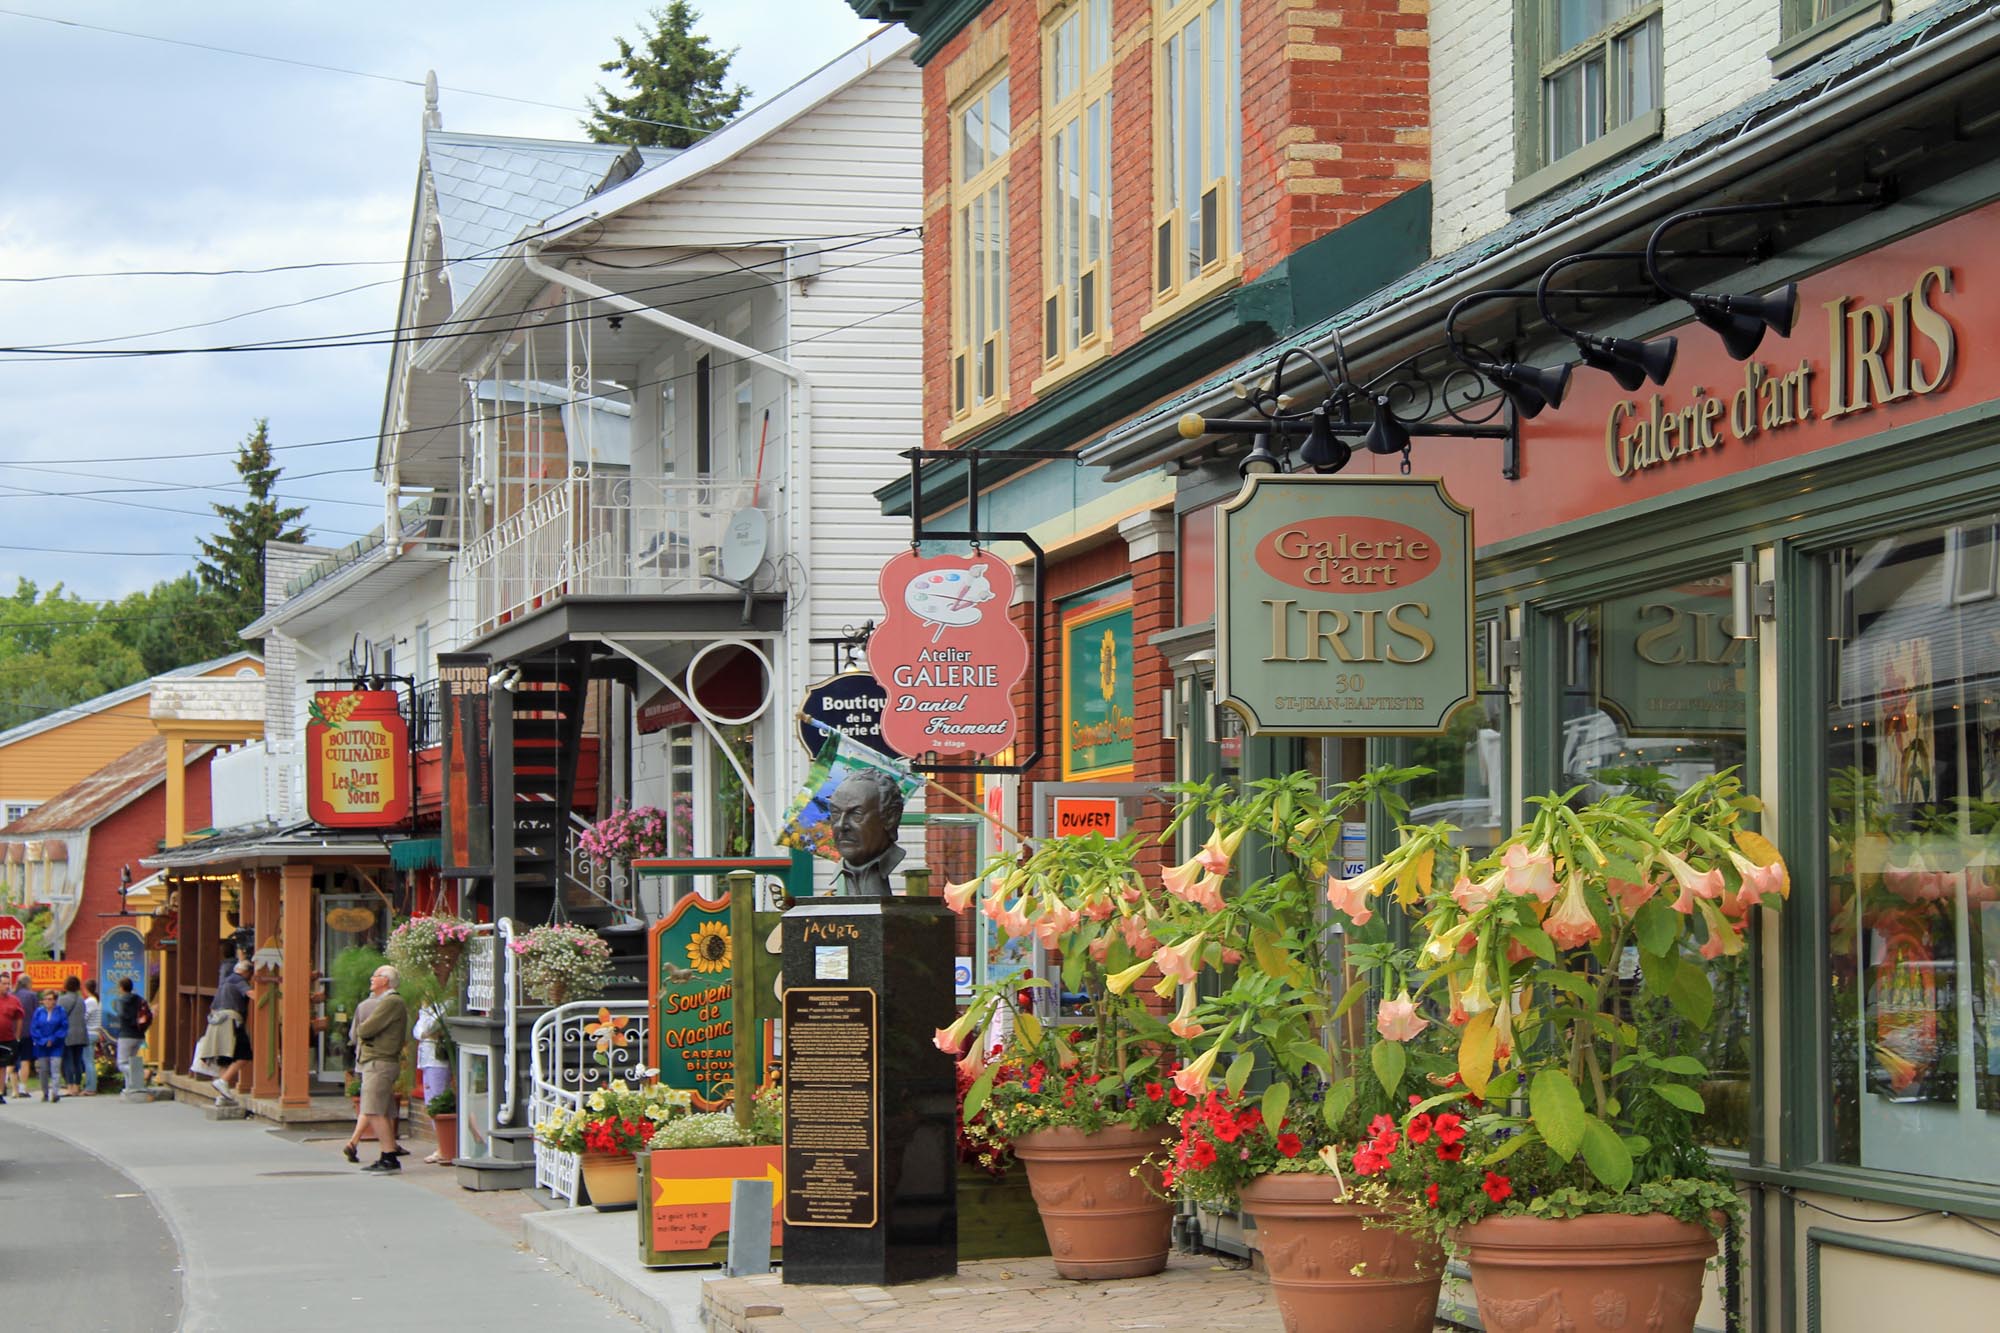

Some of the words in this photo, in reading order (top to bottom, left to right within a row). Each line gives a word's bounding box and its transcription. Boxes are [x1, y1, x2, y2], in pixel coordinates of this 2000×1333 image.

[1605, 386, 1724, 477] Galerie
[1731, 359, 1813, 440] d'art
[1821, 265, 1955, 421] IRIS
[1273, 529, 1431, 561] Galerie
[1303, 557, 1398, 586] d'art
[1261, 598, 1436, 665] IRIS
[918, 647, 972, 662] Atelier
[439, 667, 488, 682] AUTOUR
[893, 665, 999, 687] GALERIE
[1336, 673, 1364, 694] 30
[463, 681, 488, 695] POT
[822, 694, 887, 713] Boutiqu
[896, 694, 968, 712] Daniel
[846, 713, 860, 723] de
[861, 713, 872, 722] la
[924, 716, 1008, 735] Froment
[329, 729, 387, 750] BOUTIQUE
[325, 748, 391, 762] CULINAIRE
[332, 772, 350, 790] Les
[351, 768, 379, 786] Deux
[1062, 812, 1111, 828] OUVERT
[1344, 864, 1365, 875] VIS
[665, 984, 733, 1014] Souveni
[698, 1004, 721, 1022] de
[665, 1020, 734, 1049] Vacanc
[682, 1050, 732, 1060] CADEAU
